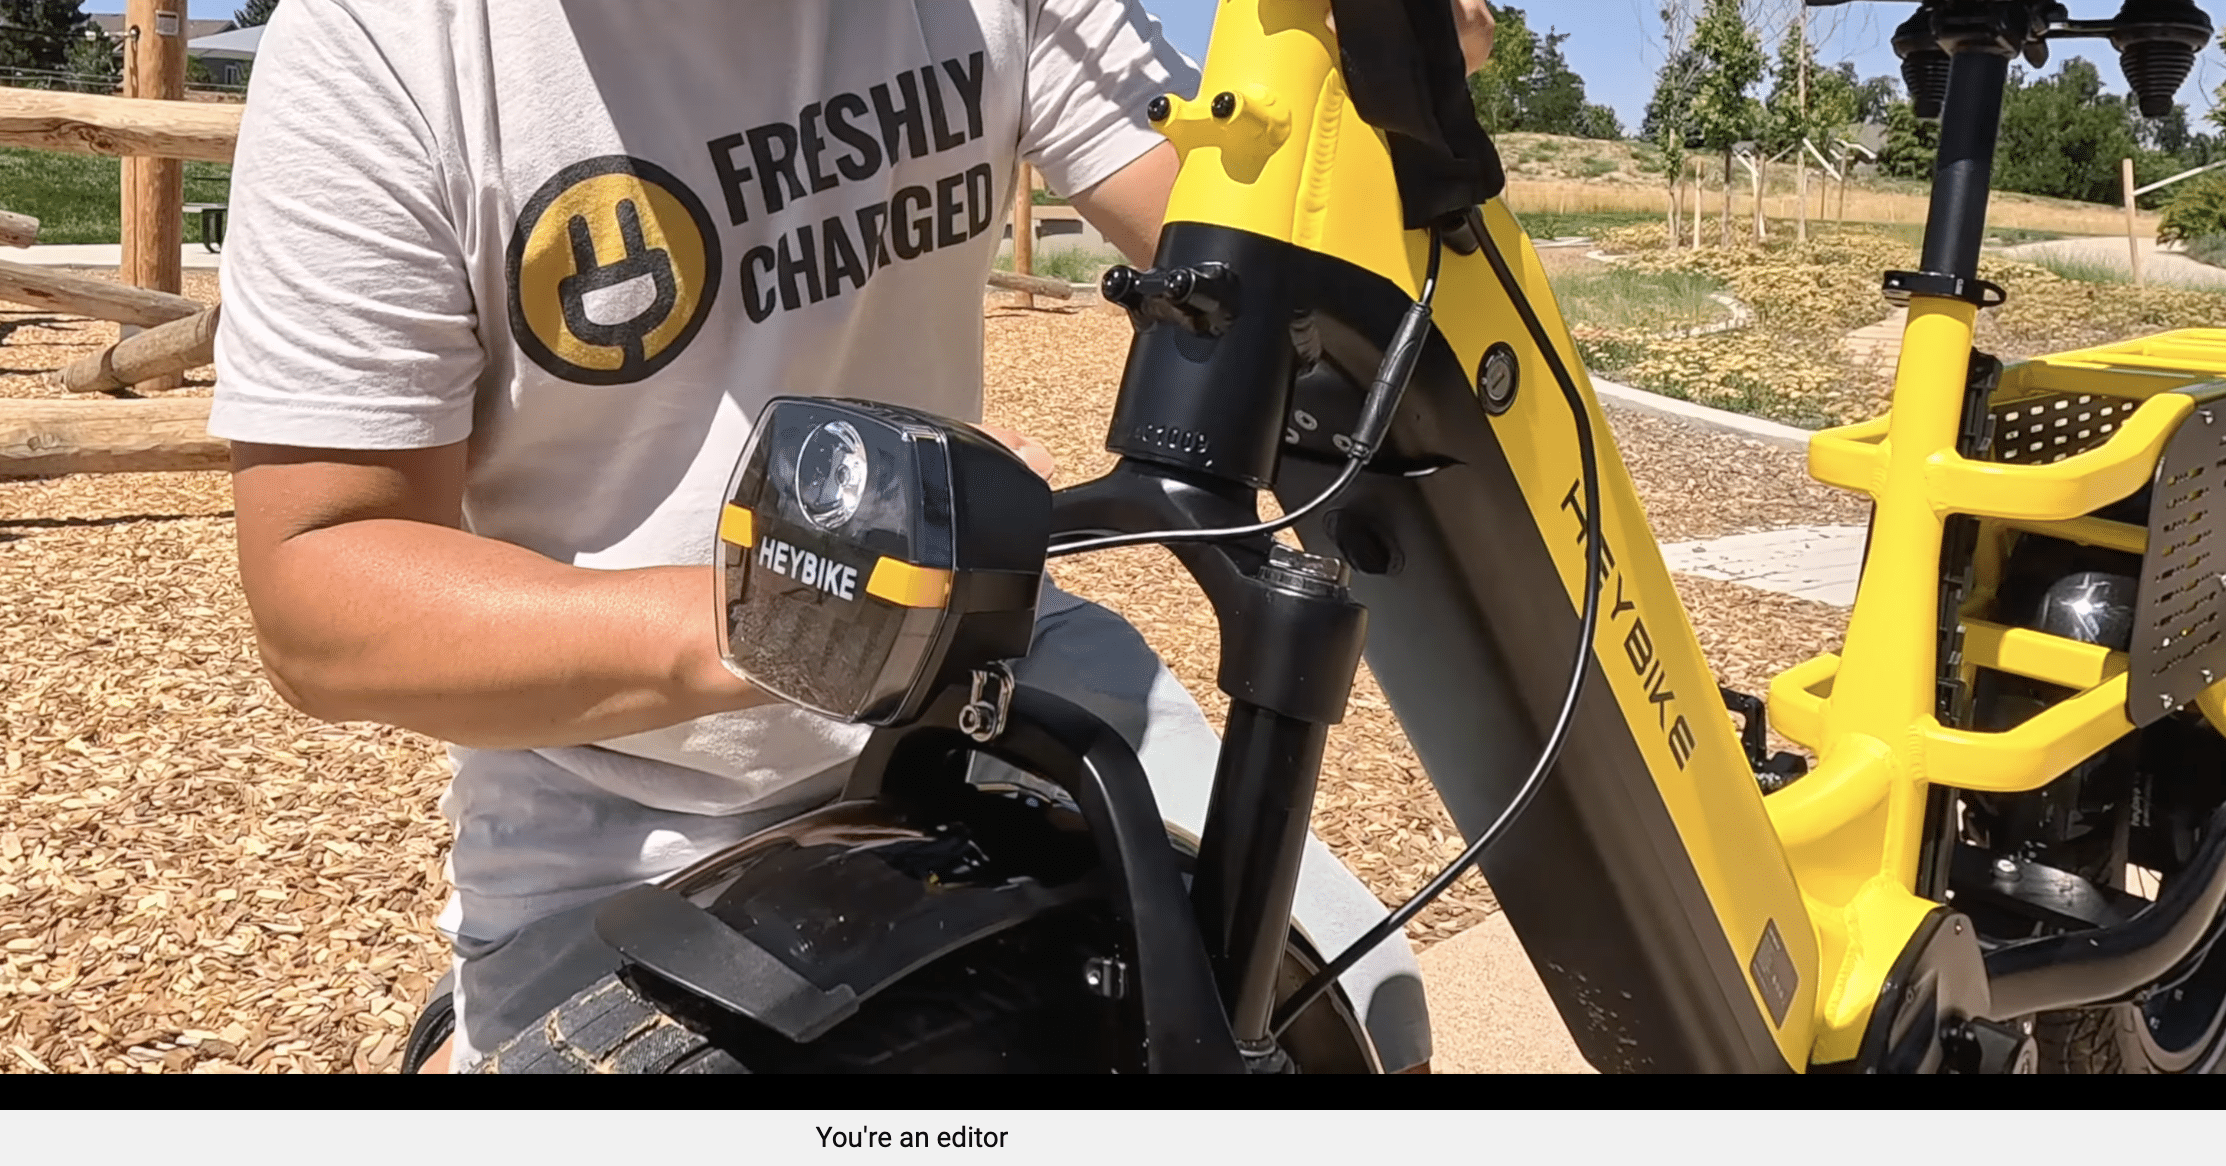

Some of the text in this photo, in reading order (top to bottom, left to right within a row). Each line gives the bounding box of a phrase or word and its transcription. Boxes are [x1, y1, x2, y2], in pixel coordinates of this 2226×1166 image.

[706, 51, 985, 227] FRESHLY
[740, 162, 993, 324] CHARGED
[758, 535, 858, 601] HEYBIKE
